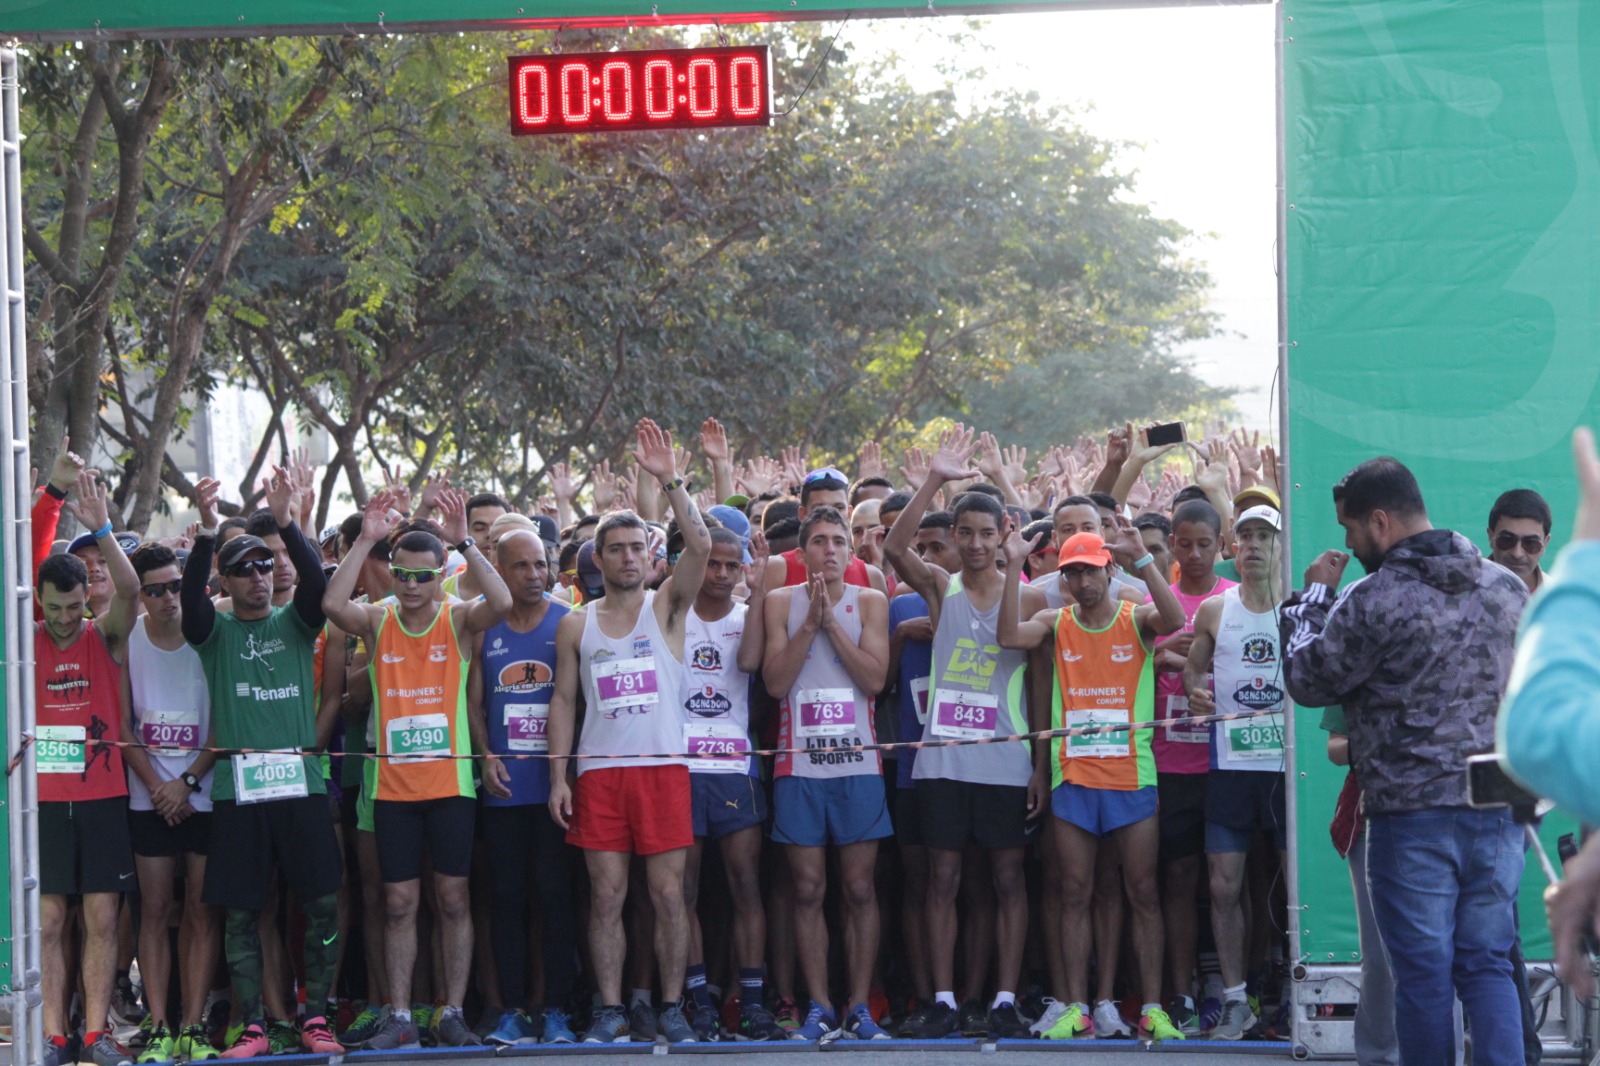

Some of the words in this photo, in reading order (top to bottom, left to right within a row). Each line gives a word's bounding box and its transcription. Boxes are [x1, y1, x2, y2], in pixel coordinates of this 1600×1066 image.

[55, 663, 80, 673] GRUPO
[494, 683, 520, 694] Alegria
[521, 682, 534, 690] em
[612, 672, 644, 692] 791
[252, 683, 299, 701] Tenaris
[705, 686, 713, 697] B
[1238, 690, 1281, 701] BENEDONI
[812, 702, 844, 720] 763
[953, 705, 985, 724] 843
[150, 725, 194, 742] 2073
[400, 728, 444, 747] 3490
[1239, 727, 1284, 744] 3038
[36, 740, 80, 757] 3566
[696, 740, 735, 755] 2736
[805, 737, 862, 749] LUASA
[809, 751, 864, 765] SPORTS
[253, 763, 297, 782] 4003
